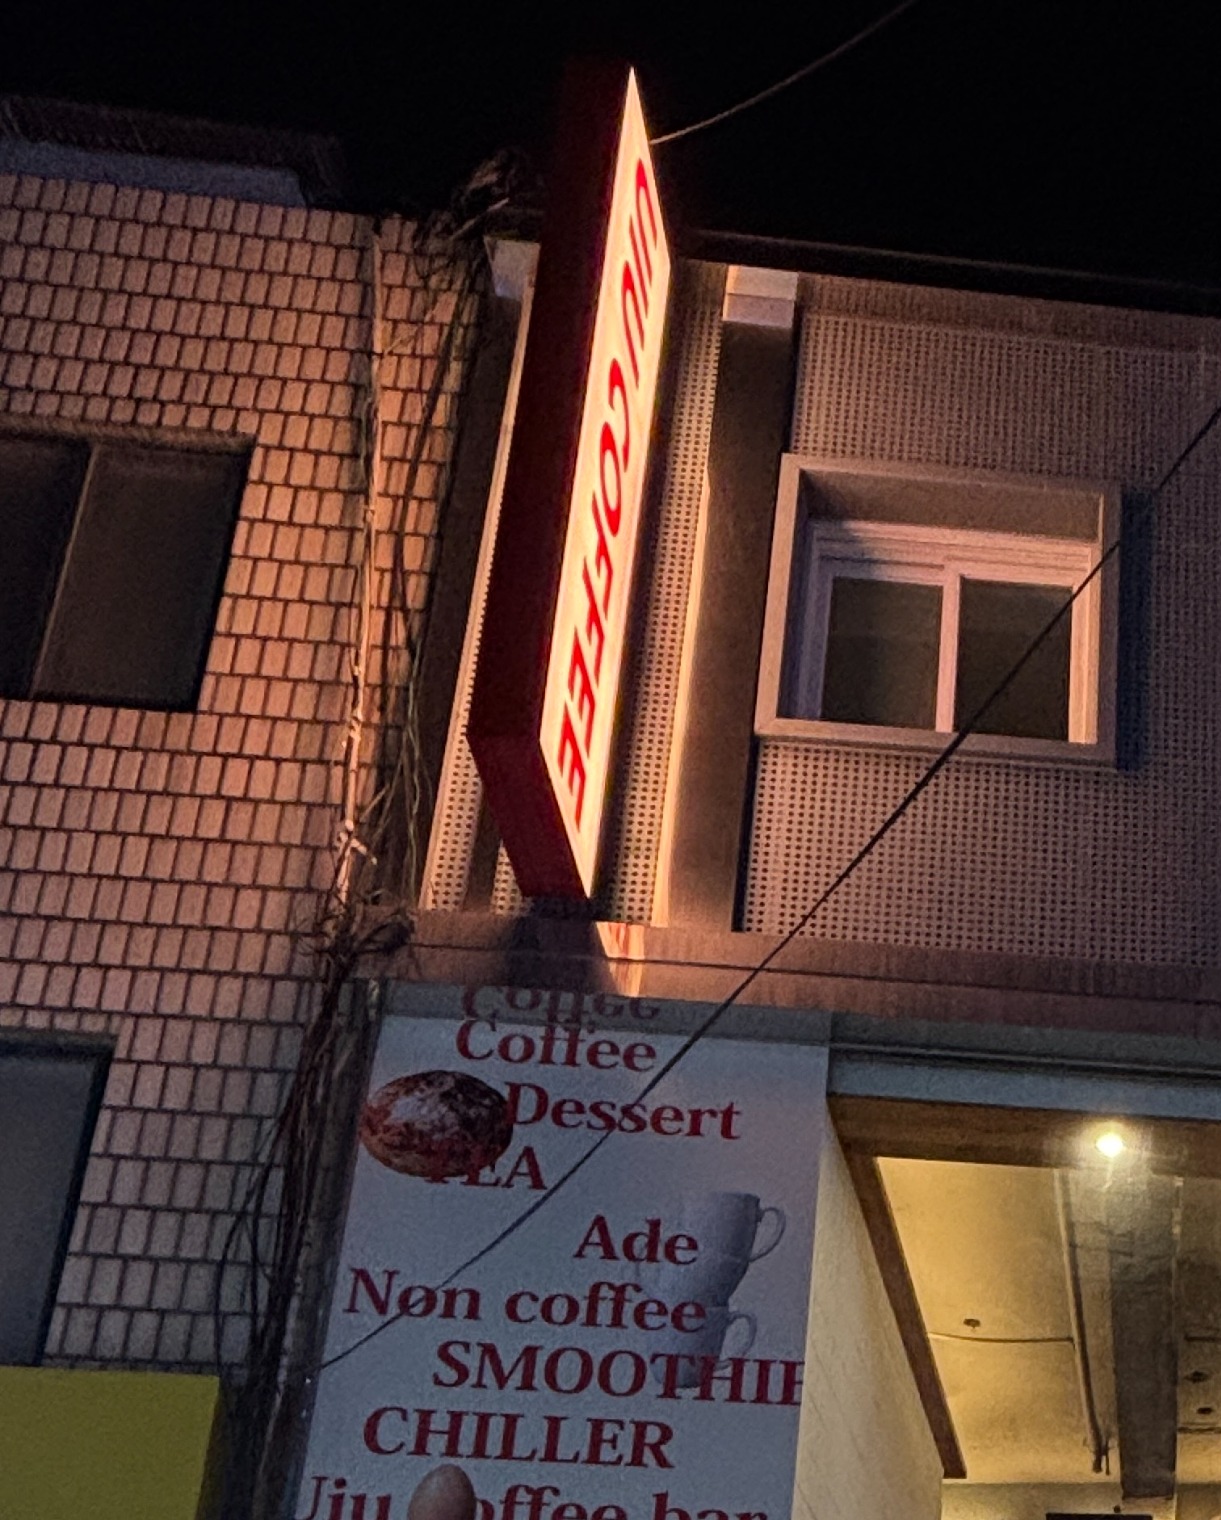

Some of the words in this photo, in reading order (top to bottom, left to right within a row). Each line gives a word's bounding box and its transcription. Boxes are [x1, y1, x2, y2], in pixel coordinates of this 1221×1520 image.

[620, 158, 658, 390] UIU
[557, 357, 631, 833] COFFEE
[456, 1016, 656, 1072] Coffee
[505, 1080, 742, 1140] Dessert
[573, 1214, 699, 1266] Ade
[343, 1266, 481, 1321] Non
[504, 1280, 707, 1333] coffee
[362, 1406, 675, 1469] CHILLER
